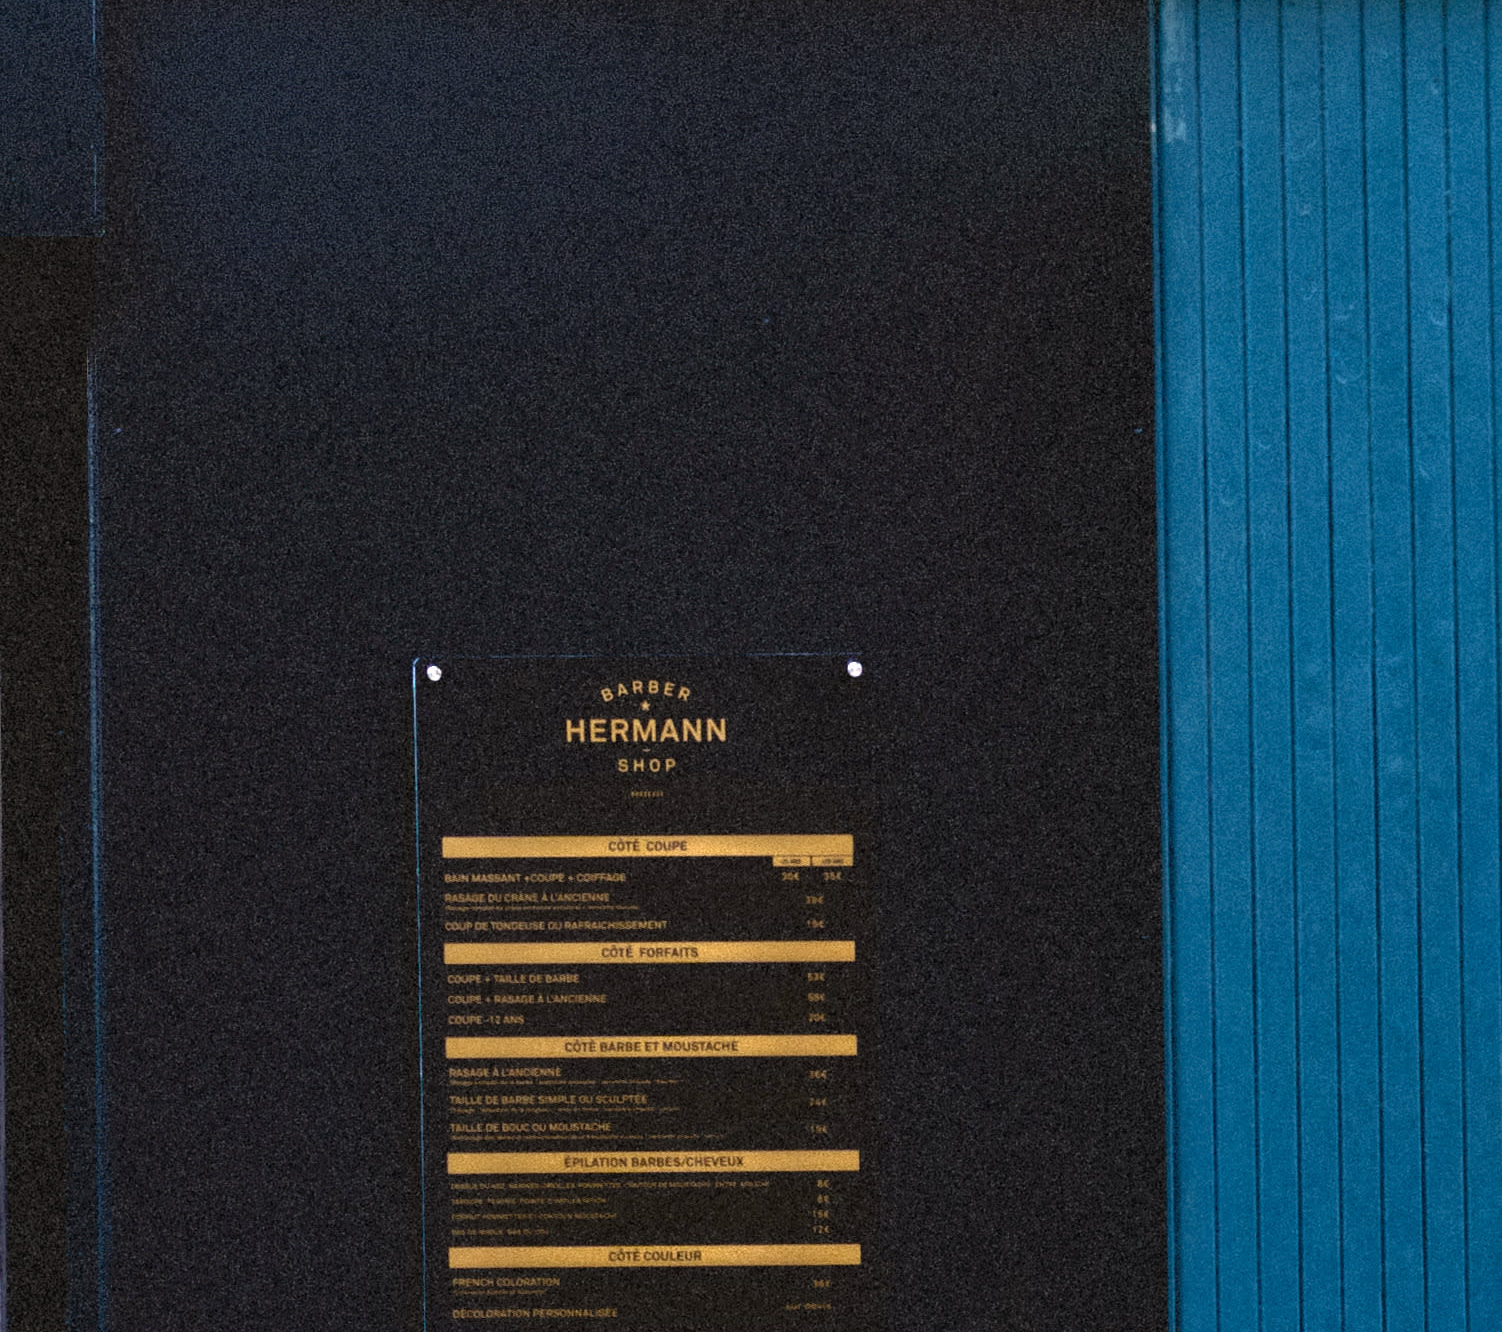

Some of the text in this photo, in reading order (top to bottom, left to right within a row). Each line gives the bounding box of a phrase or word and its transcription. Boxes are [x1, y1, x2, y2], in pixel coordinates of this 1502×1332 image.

[600, 679, 691, 702] BARBER
[565, 718, 727, 743] HERMANN
[617, 757, 677, 773] SHOP
[607, 837, 688, 853] CÔTÉ COUPE
[443, 873, 470, 883] BAIN
[470, 872, 522, 883] MASSANT
[443, 893, 485, 904] RASAGE
[487, 893, 503, 903] DU
[600, 944, 699, 960] CÔTÉ FORFAITS
[447, 974, 482, 984] COUPE
[493, 974, 527, 984] TAILLE
[528, 973, 543, 984] DE
[447, 994, 482, 1005] COUPE
[493, 994, 535, 1004] RASAGE
[447, 1014, 483, 1025] COUPE
[563, 1038, 739, 1054] CÔTÉ BARBE ET MOUSTACHE
[448, 1067, 490, 1078] RASAGE
[449, 1095, 483, 1106] TAILLE
[484, 1095, 499, 1106] DE
[500, 1094, 535, 1105] BARBE
[537, 1094, 576, 1105] SIMPLE
[578, 1095, 593, 1104] OU
[450, 1123, 483, 1133] TAILLE
[485, 1122, 499, 1133] DE
[531, 1122, 547, 1132] OU
[548, 1121, 611, 1132] MOUSTACHE
[630, 1155, 744, 1168] BARBES/CHEVEUX
[607, 1246, 702, 1264] CÔTÉ COULEUR
[451, 1277, 561, 1288] FRENCH COLORATION
